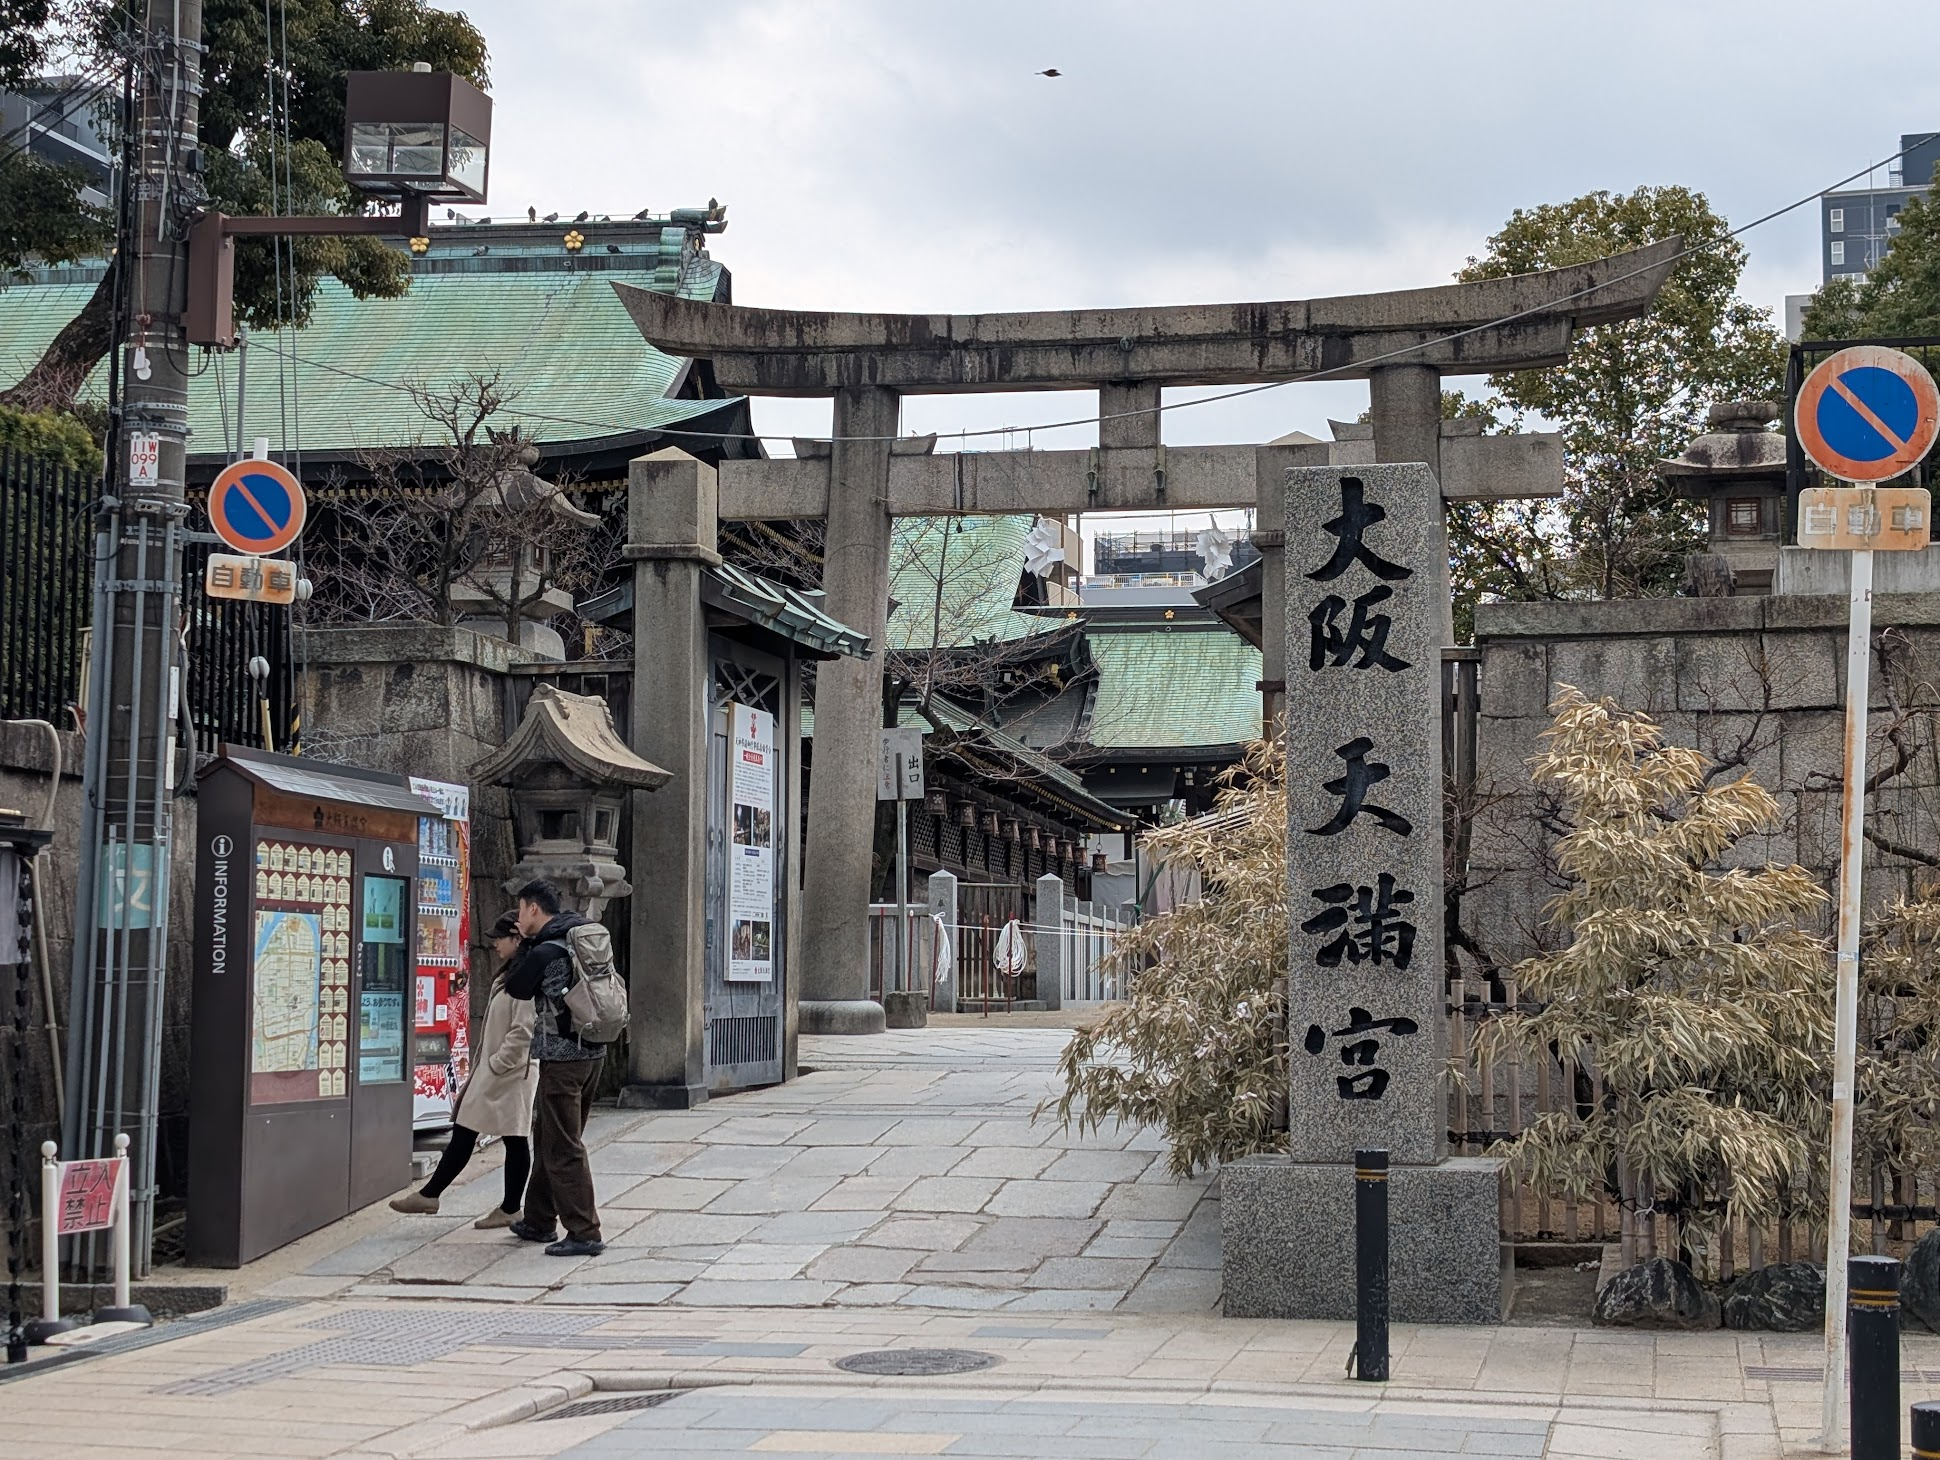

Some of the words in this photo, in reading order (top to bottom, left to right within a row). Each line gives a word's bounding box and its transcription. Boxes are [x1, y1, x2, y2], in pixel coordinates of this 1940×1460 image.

[131, 453, 157, 466] 099
[138, 465, 148, 478] A
[1804, 502, 1924, 537] 自動車
[211, 563, 292, 593] 自動車
[908, 754, 920, 783] 出口
[1301, 476, 1420, 1101] 大阪天満宮
[212, 860, 228, 974] INFORMATION
[66, 1162, 112, 1195] 立入
[63, 1194, 107, 1230] 禁止
